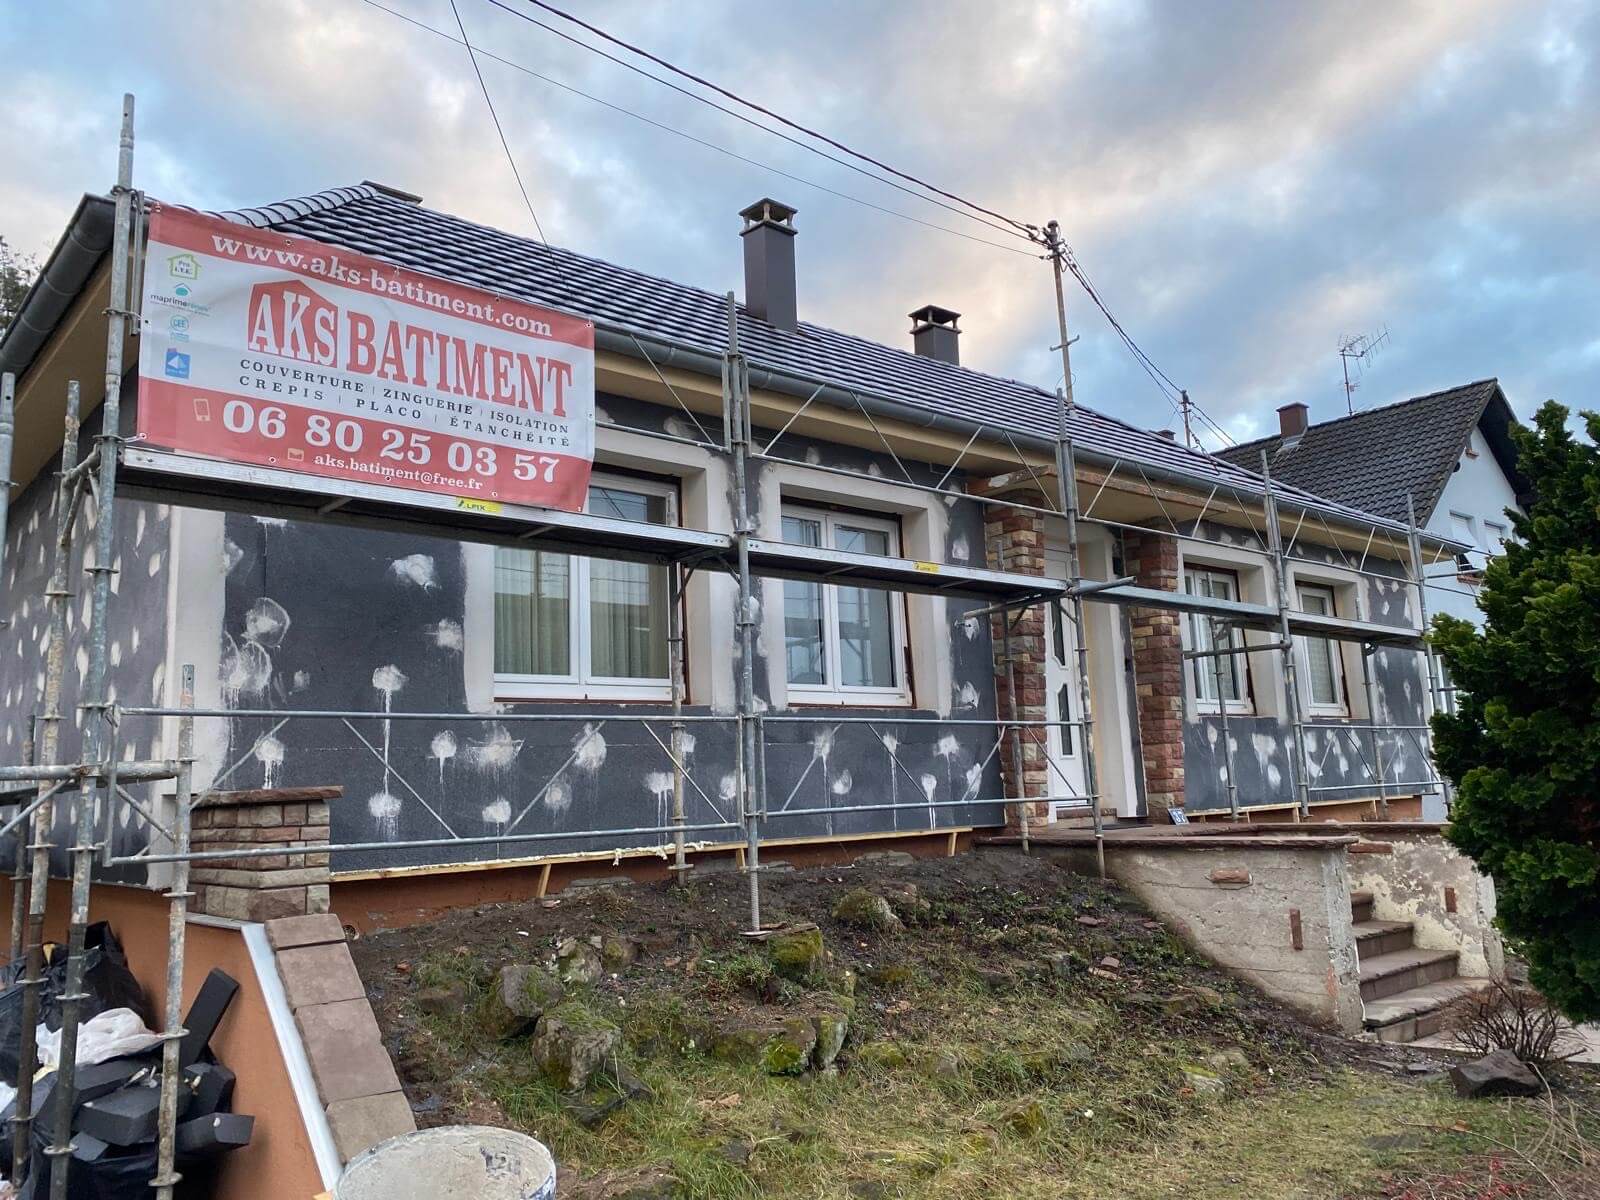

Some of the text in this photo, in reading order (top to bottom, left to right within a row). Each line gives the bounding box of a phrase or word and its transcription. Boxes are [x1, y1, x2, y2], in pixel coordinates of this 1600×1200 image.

[212, 235, 552, 336] www.aks-batiment.com
[249, 290, 572, 417] AKS BATIMENT
[239, 376, 570, 447] CREPIS PLACO ÉTANCHÉITÉ
[240, 359, 569, 434] COUVERTURE ZINGUERIE ISOLATION
[223, 400, 560, 483] 06 80 25 03 57
[314, 453, 483, 490] aks.batiment@free.fr
